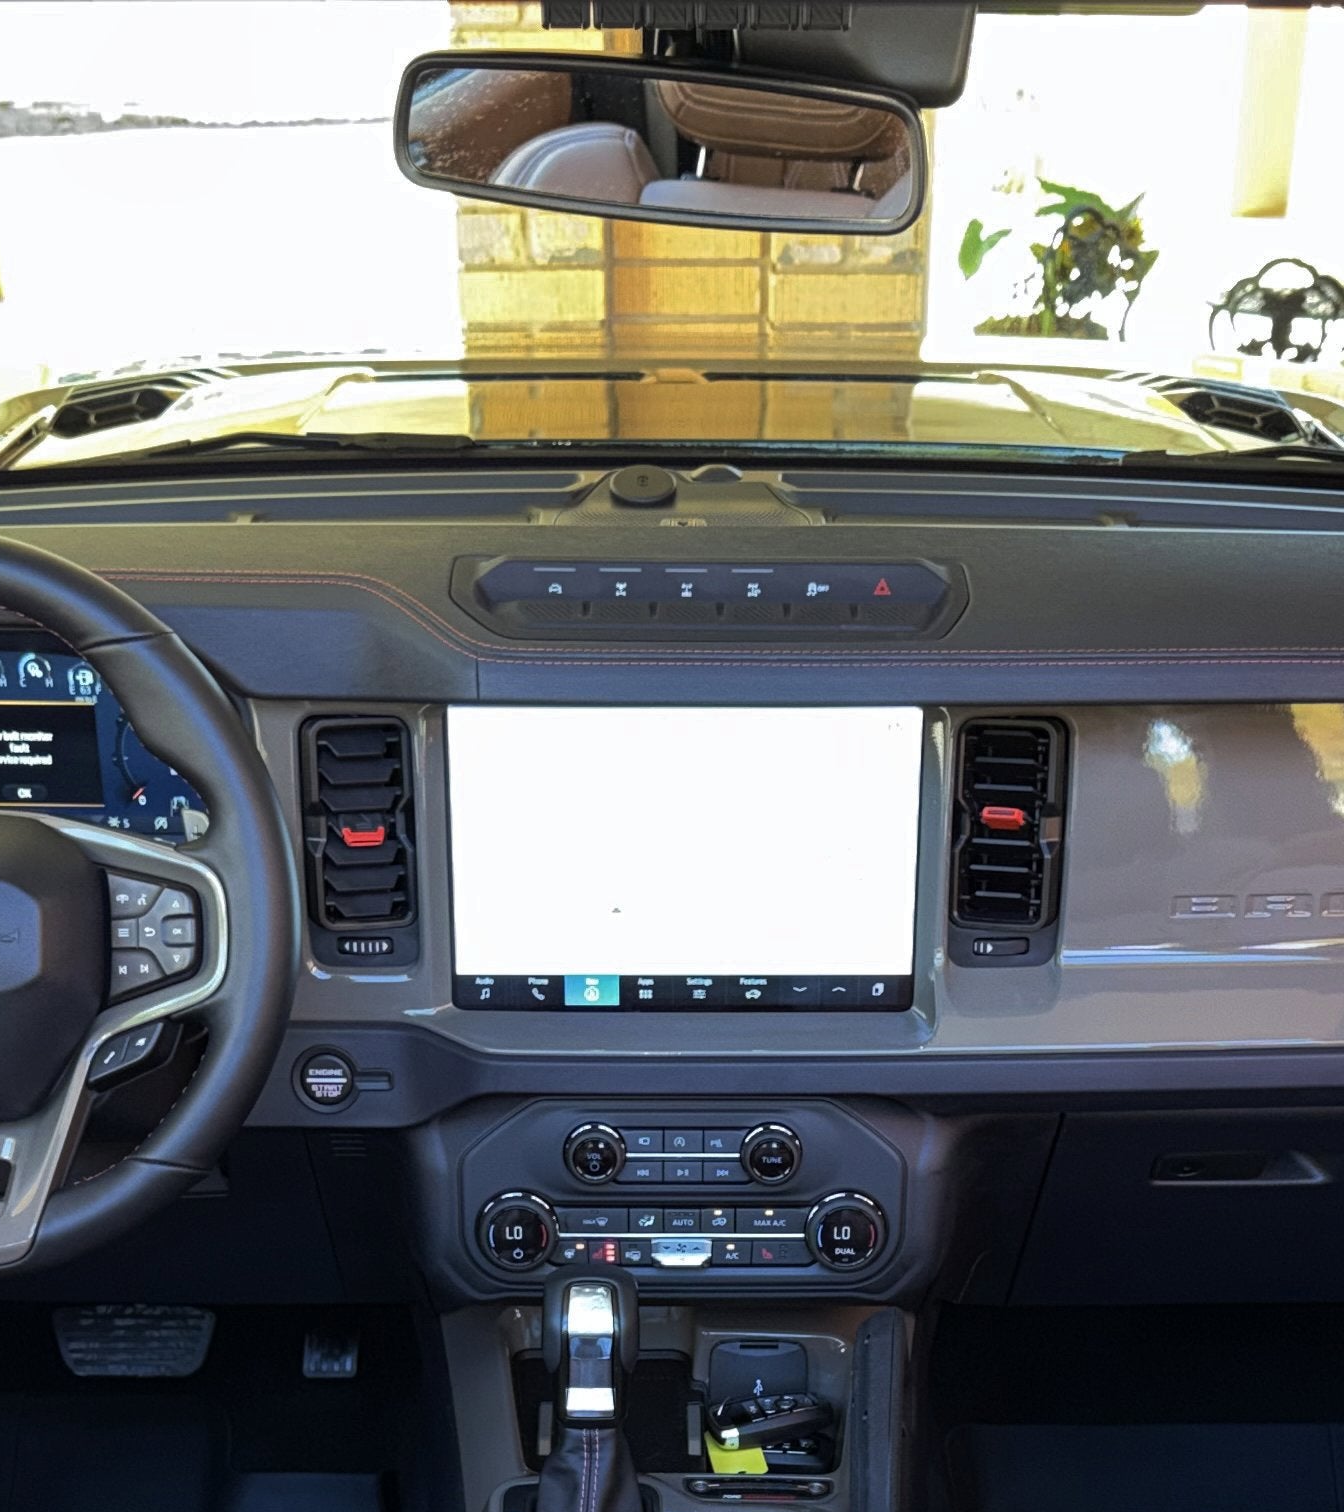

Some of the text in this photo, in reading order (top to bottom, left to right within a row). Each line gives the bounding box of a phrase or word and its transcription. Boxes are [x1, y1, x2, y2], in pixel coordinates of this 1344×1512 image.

[586, 1152, 602, 1160] VOL
[761, 1156, 783, 1164] TUNE
[672, 1219, 694, 1227] AUTO
[753, 1219, 772, 1227] MAX
[505, 1226, 523, 1241] LO
[833, 1226, 851, 1240] LO
[834, 1247, 856, 1255] DUAL
[725, 1251, 739, 1260] A/C
